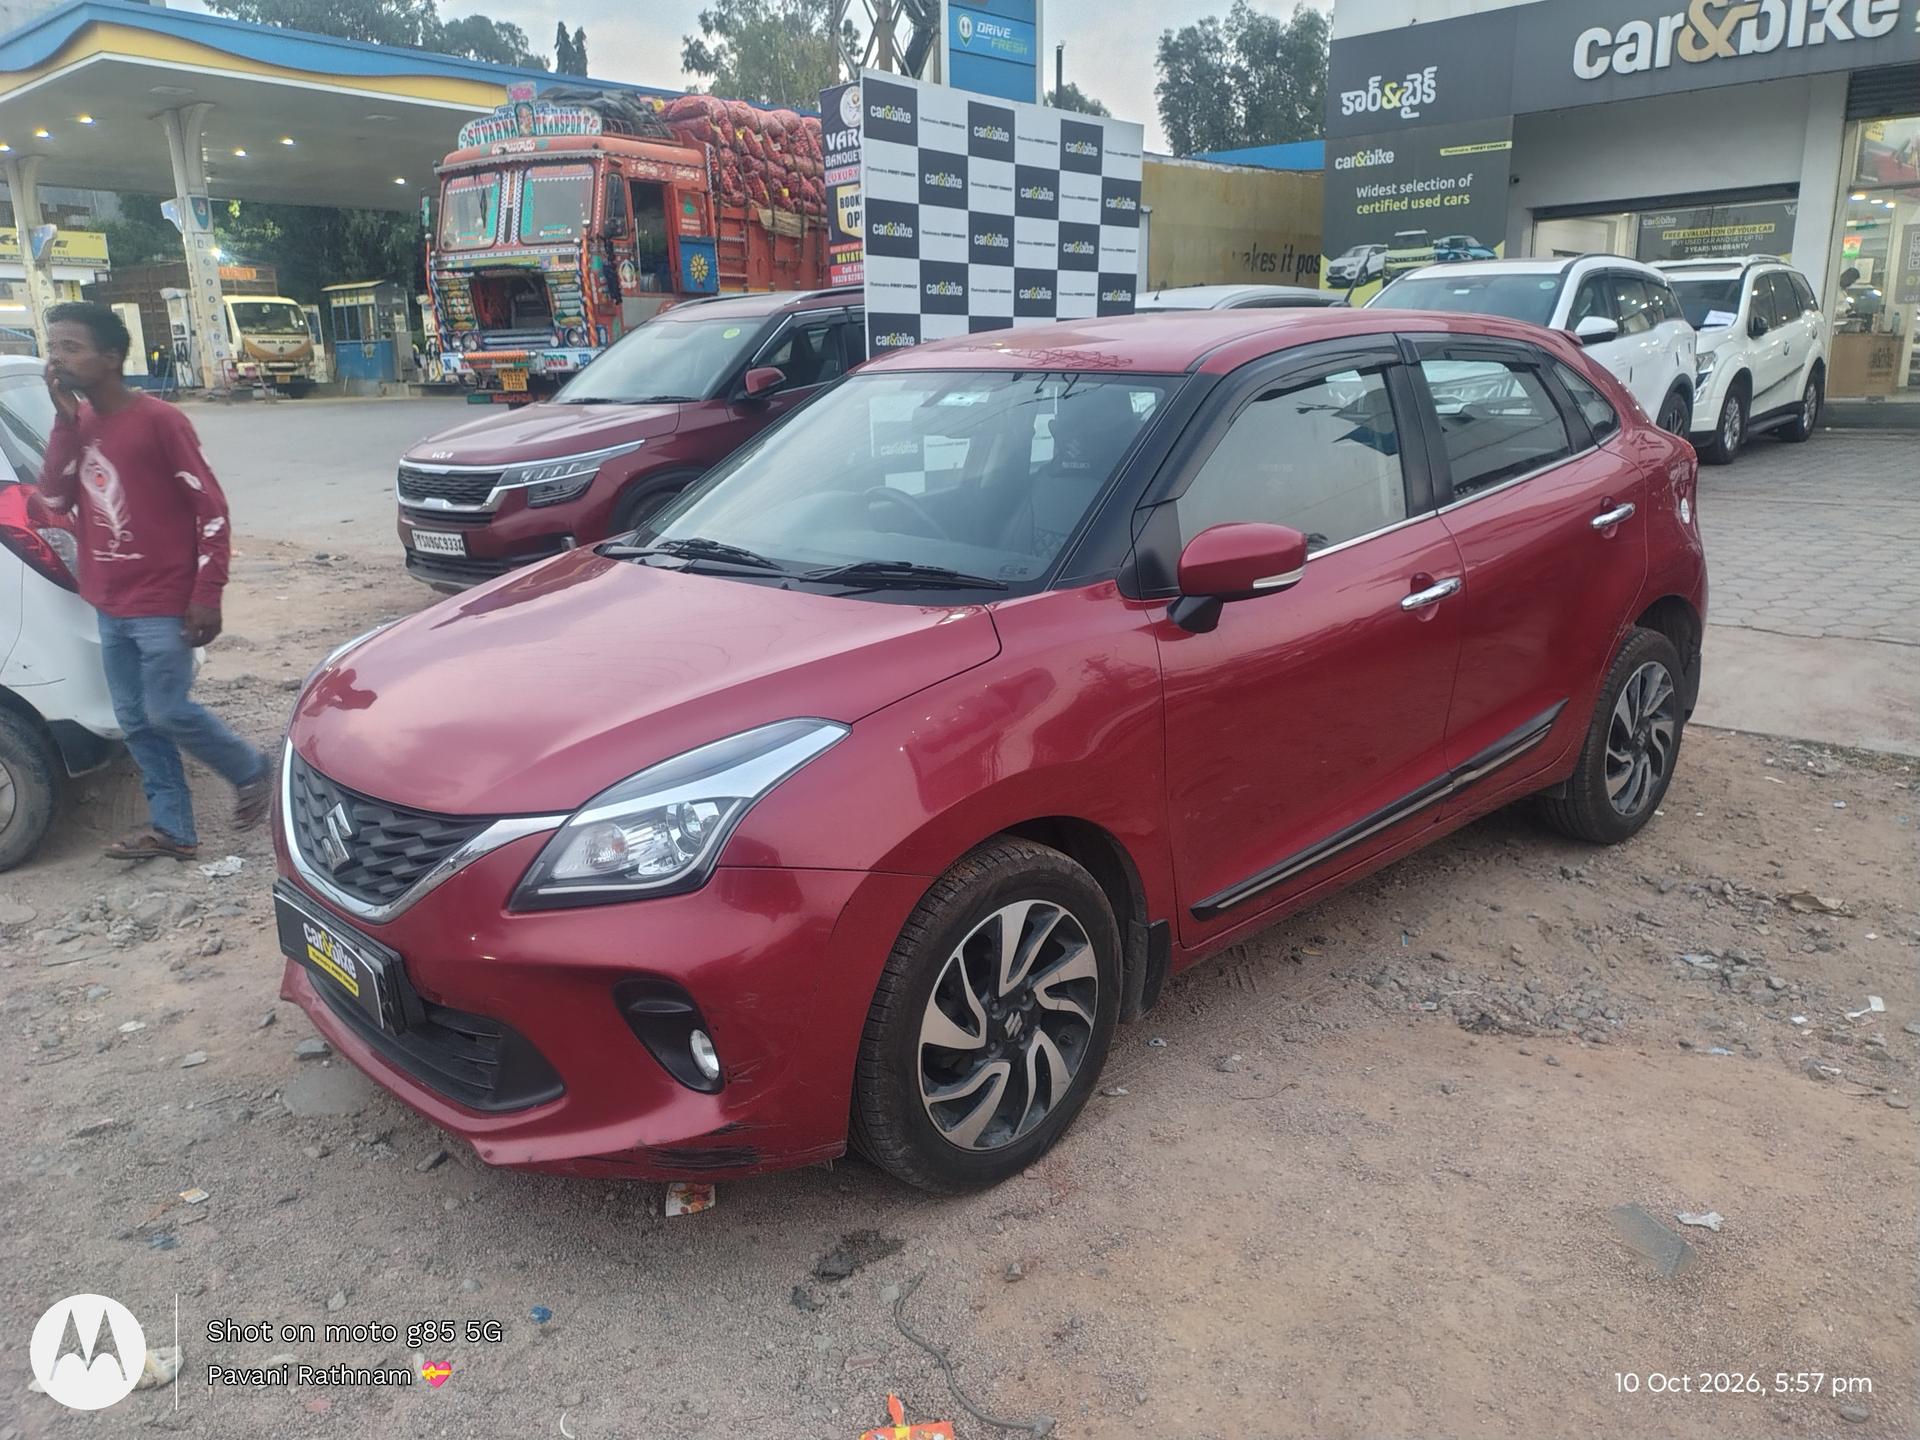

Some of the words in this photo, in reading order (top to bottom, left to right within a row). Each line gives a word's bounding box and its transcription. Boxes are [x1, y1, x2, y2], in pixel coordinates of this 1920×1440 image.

[977, 22, 1011, 39] DRIVE
[991, 38, 1027, 55] FRESH
[1573, 0, 1898, 80] car&bike
[1340, 66, 1437, 119] కార్&బైక్
[475, 111, 515, 126] NATIONAL
[870, 105, 911, 124] car&bike
[467, 119, 518, 146] SUVARNA
[535, 114, 590, 135] TRANSPORT
[974, 125, 1009, 142] car&bike
[1065, 141, 1098, 156] car&bike
[1335, 149, 1394, 169] car&bike
[826, 167, 859, 183] LUXURY
[925, 172, 962, 189] car&bike
[1020, 186, 1054, 201] car&bike
[1356, 184, 1397, 198] Widest
[1399, 176, 1455, 194] selection
[1458, 173, 1473, 187] of
[1106, 197, 1136, 211] car&bike
[1356, 197, 1408, 215] certified
[1411, 194, 1441, 208] used
[1444, 193, 1470, 205] cars
[872, 222, 912, 238] car&bike
[974, 233, 1009, 248] car&bike
[1063, 241, 1094, 255] car&bike
[1712, 243, 1750, 251] WARRANTY
[1280, 244, 1294, 273] it
[926, 281, 963, 296] car&bike
[1019, 287, 1052, 300] car&bike
[1102, 289, 1131, 303] car&bike
[875, 333, 915, 347] car&bike
[303, 923, 356, 980] car&bike
